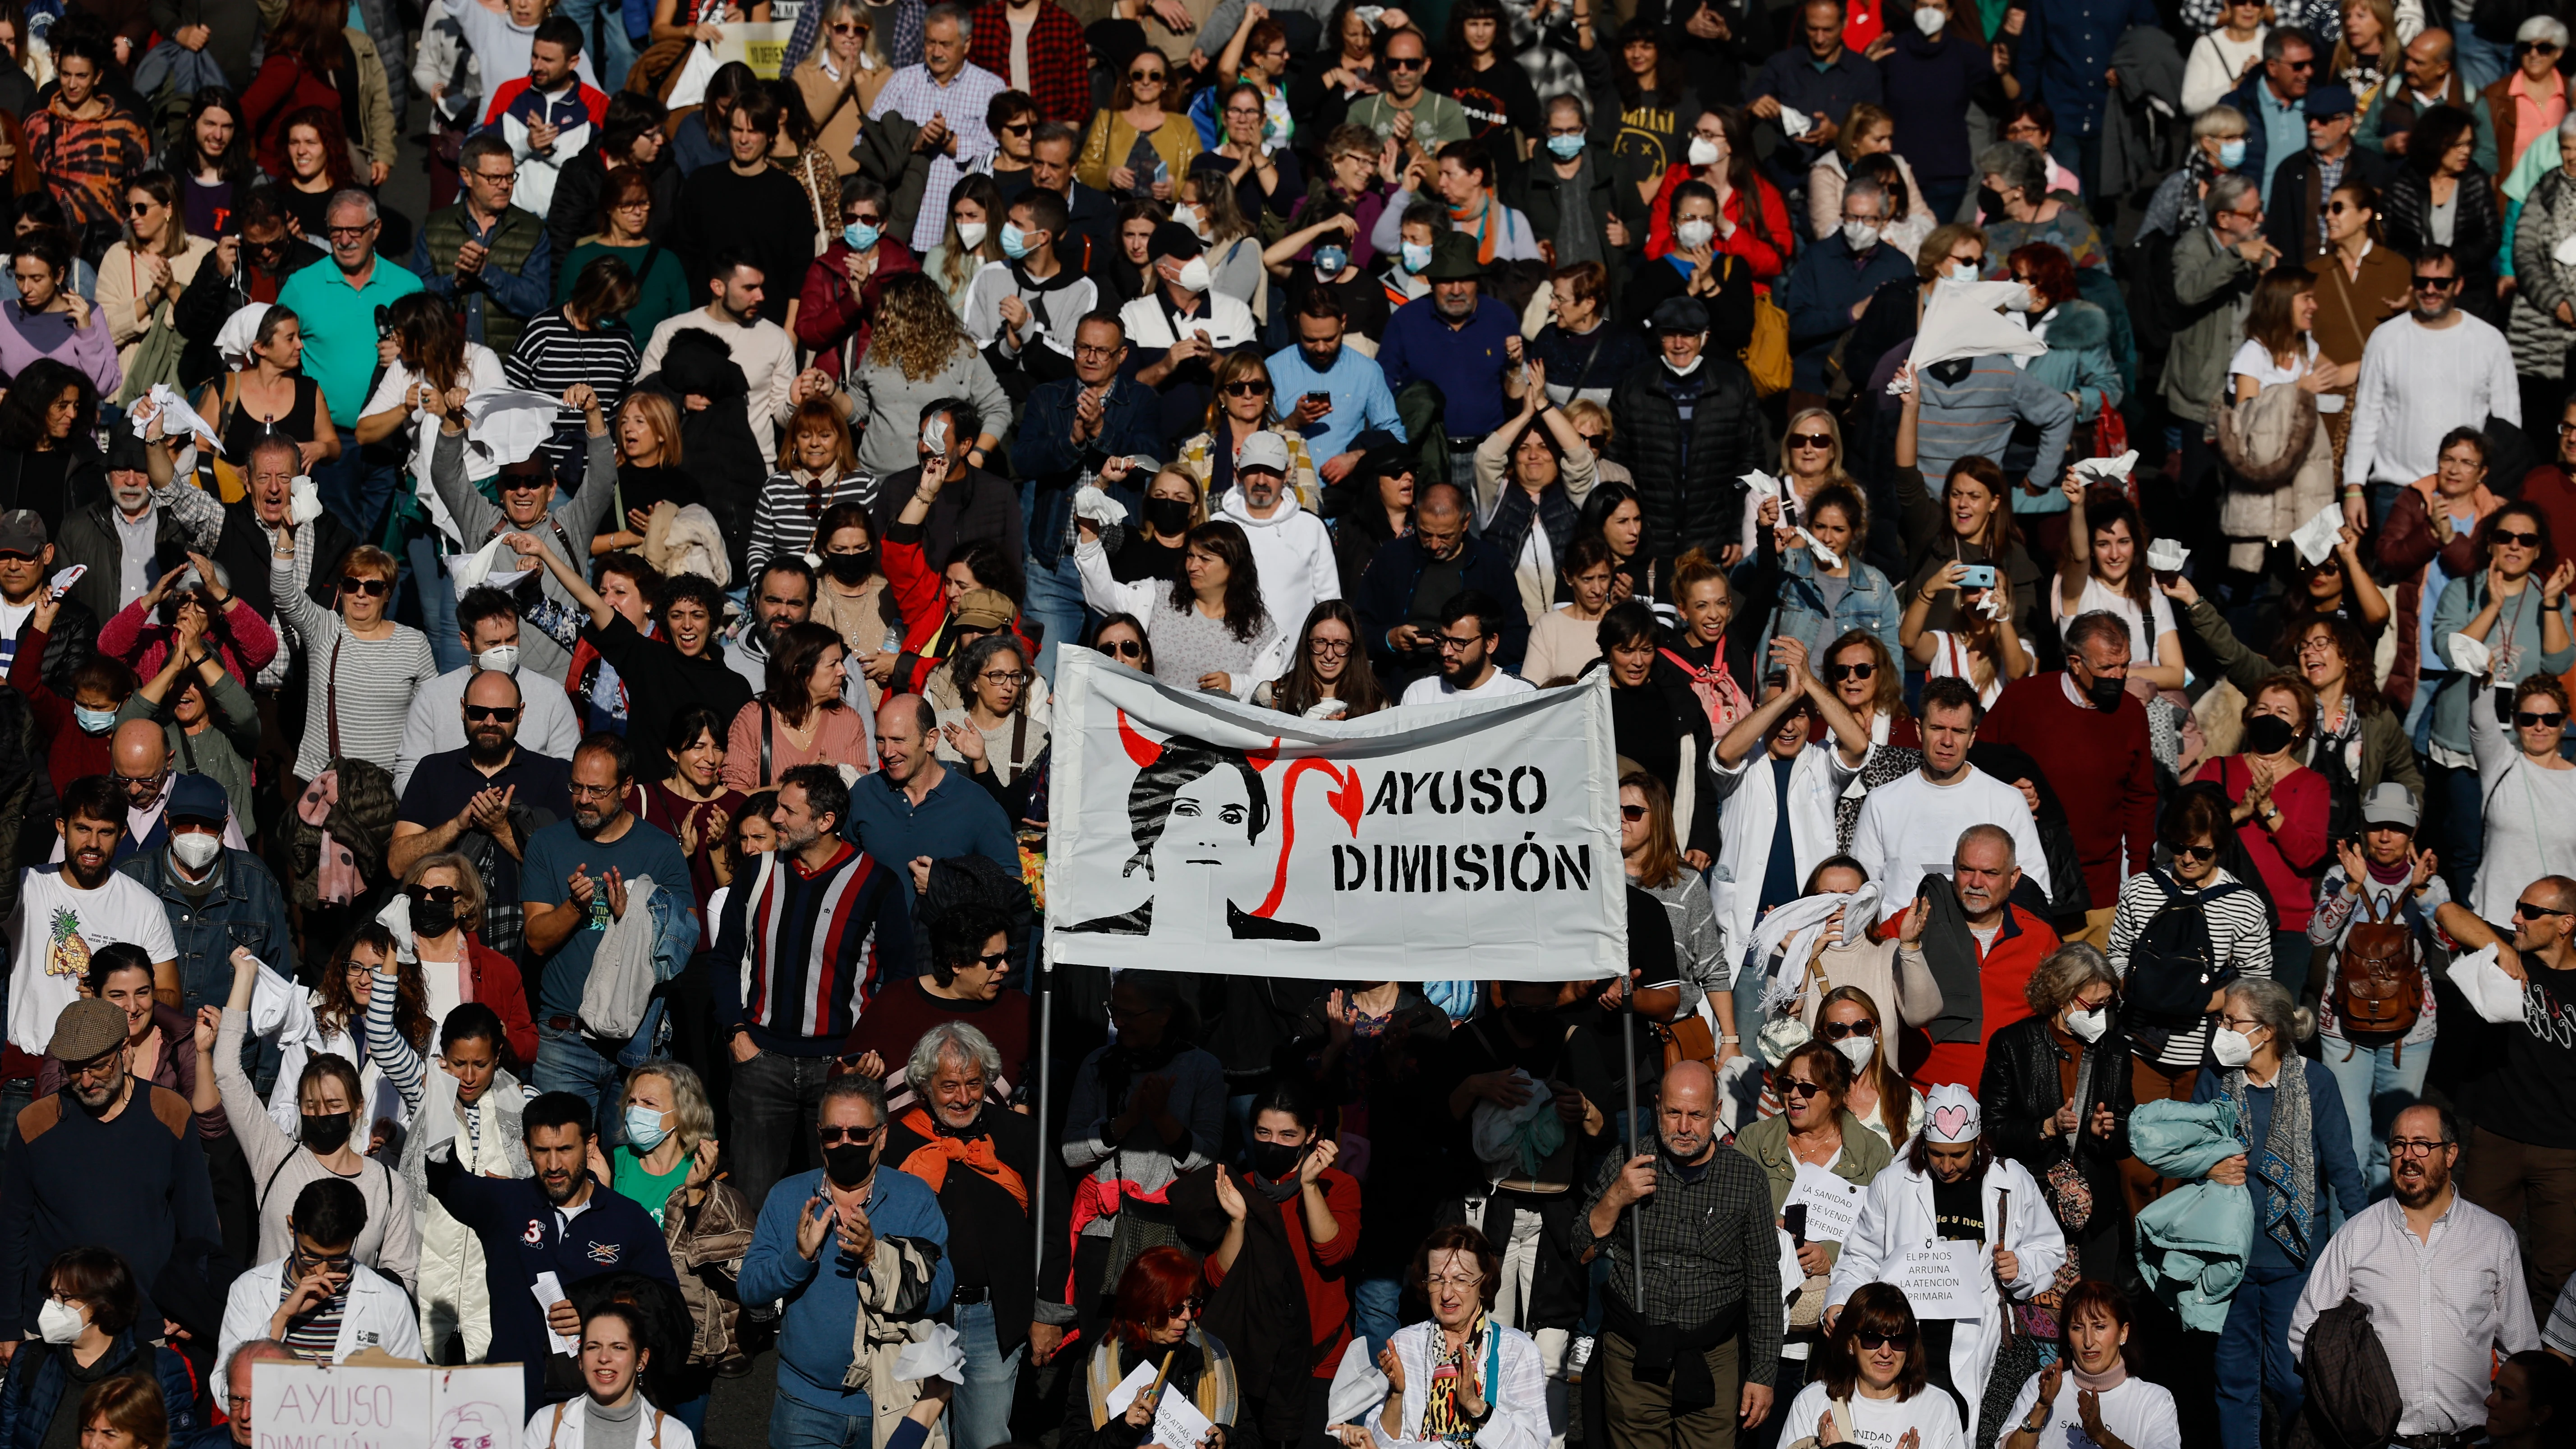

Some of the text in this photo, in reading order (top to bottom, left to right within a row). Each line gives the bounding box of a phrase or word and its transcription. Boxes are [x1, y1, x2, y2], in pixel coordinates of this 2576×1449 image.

[1366, 766, 1547, 815] AYUSO
[1332, 832, 1591, 892] DIMISIÓN
[1803, 1184, 1852, 1208] LA SANIDAD
[1796, 1198, 1853, 1225] NO SE VENDE
[524, 1219, 541, 1243] 3
[1805, 1216, 1845, 1237] DEFIENDE
[1963, 1217, 1984, 1228] nuc
[520, 1236, 544, 1250] POLO
[1907, 1253, 1916, 1261] EL
[1932, 1252, 1951, 1260] NOS
[1909, 1265, 1950, 1274] ARRUINA
[1914, 1278, 1959, 1287] ATENCION
[1908, 1292, 1953, 1301] PRIMARIA
[274, 1384, 392, 1428] AYUSO
[1160, 1424, 1186, 1449] PUBLICA
[1853, 1429, 1892, 1443] ANIDAD
